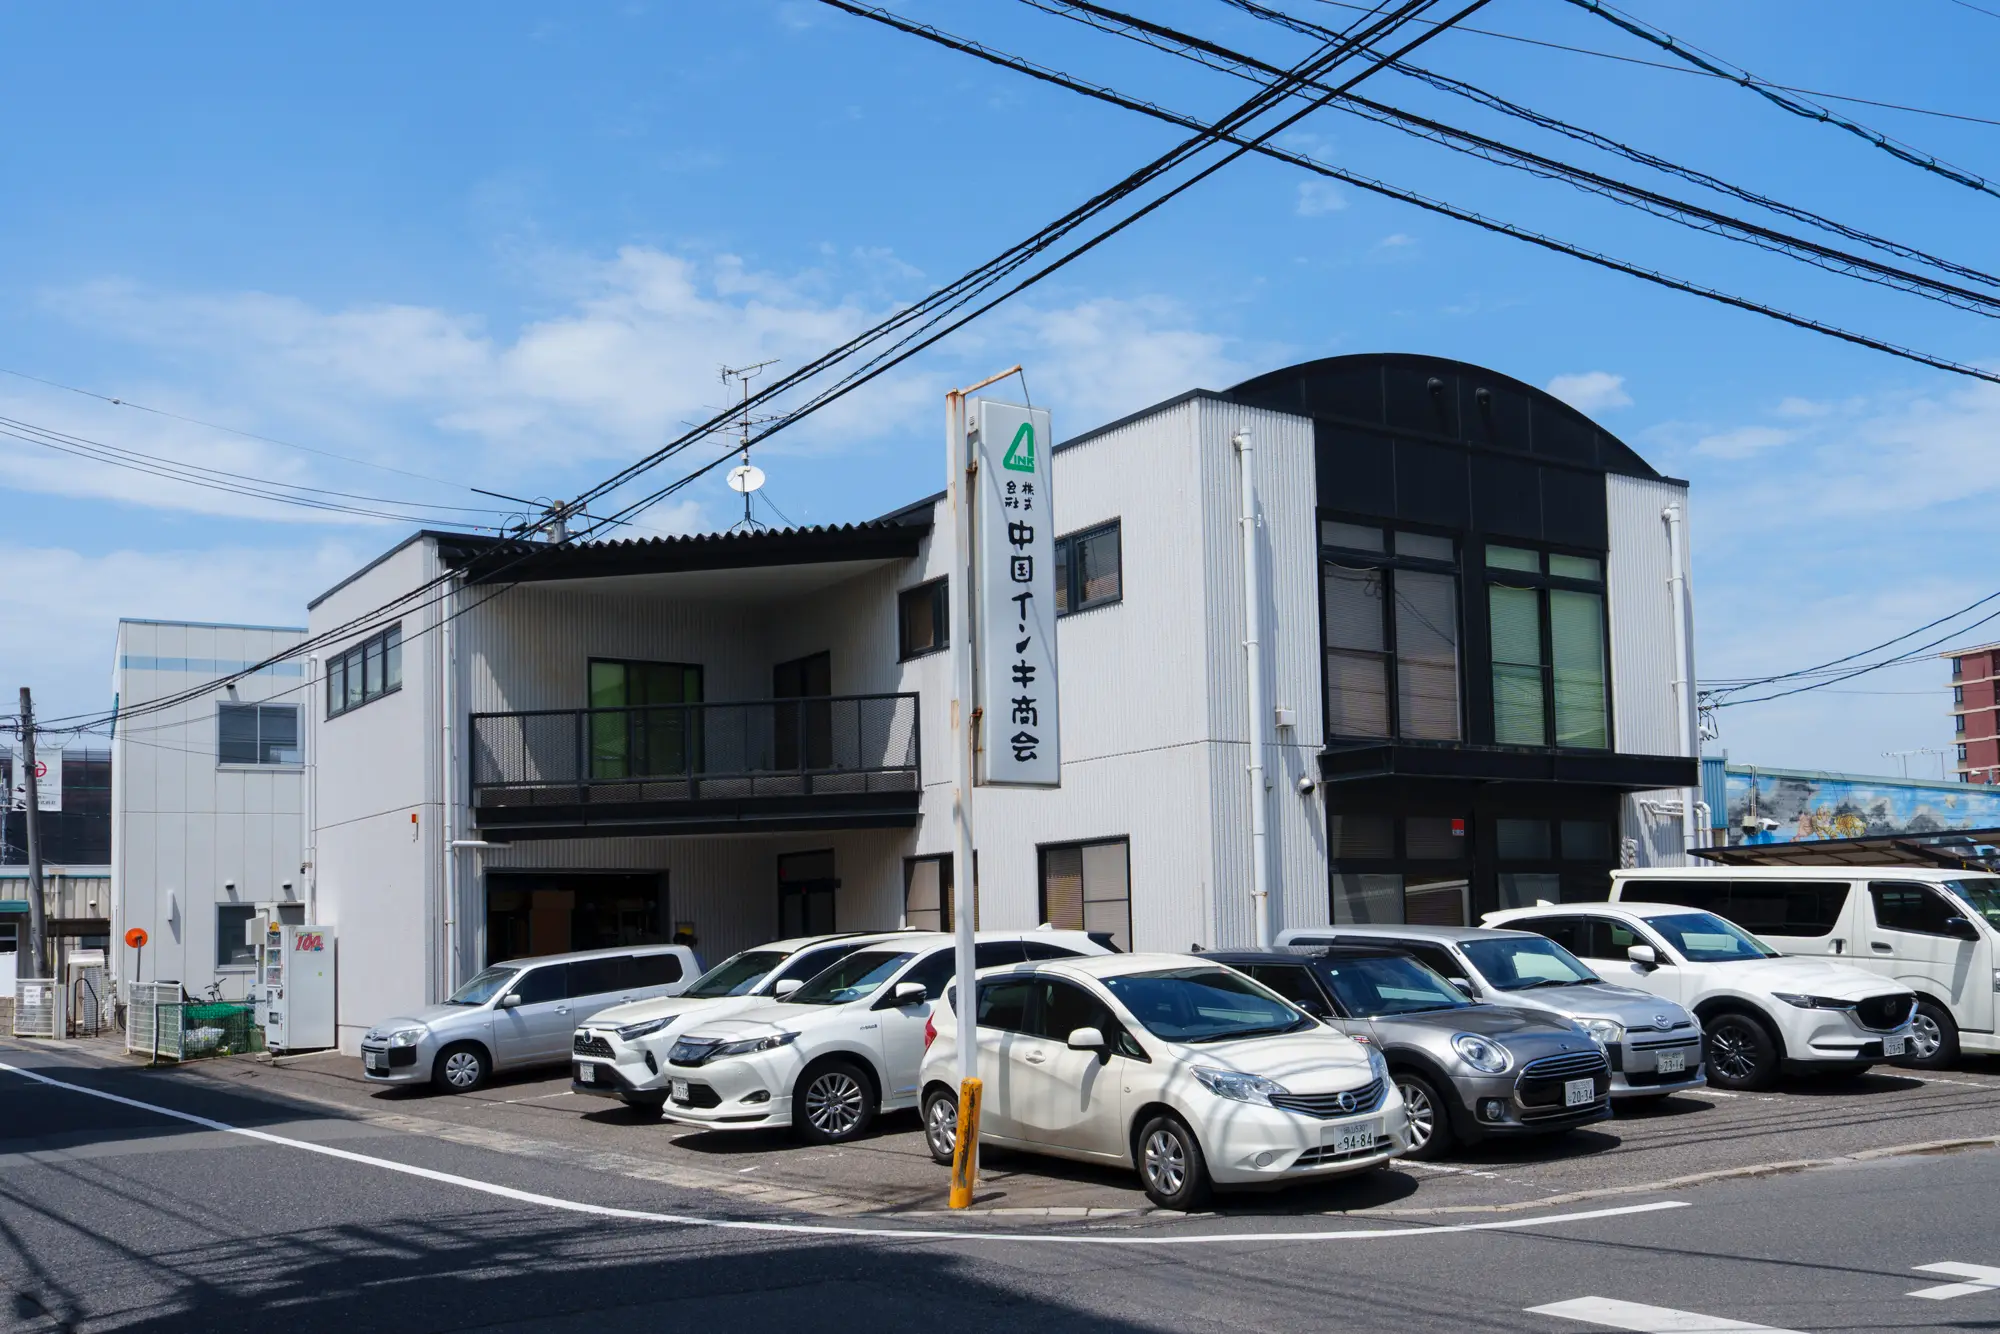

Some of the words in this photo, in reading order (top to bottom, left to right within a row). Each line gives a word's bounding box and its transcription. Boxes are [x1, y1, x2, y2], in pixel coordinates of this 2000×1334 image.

[1007, 519, 1040, 763] 中国インキ商会
[1571, 1088, 1593, 1104] 20-34
[1343, 1132, 1373, 1150] 94-84
